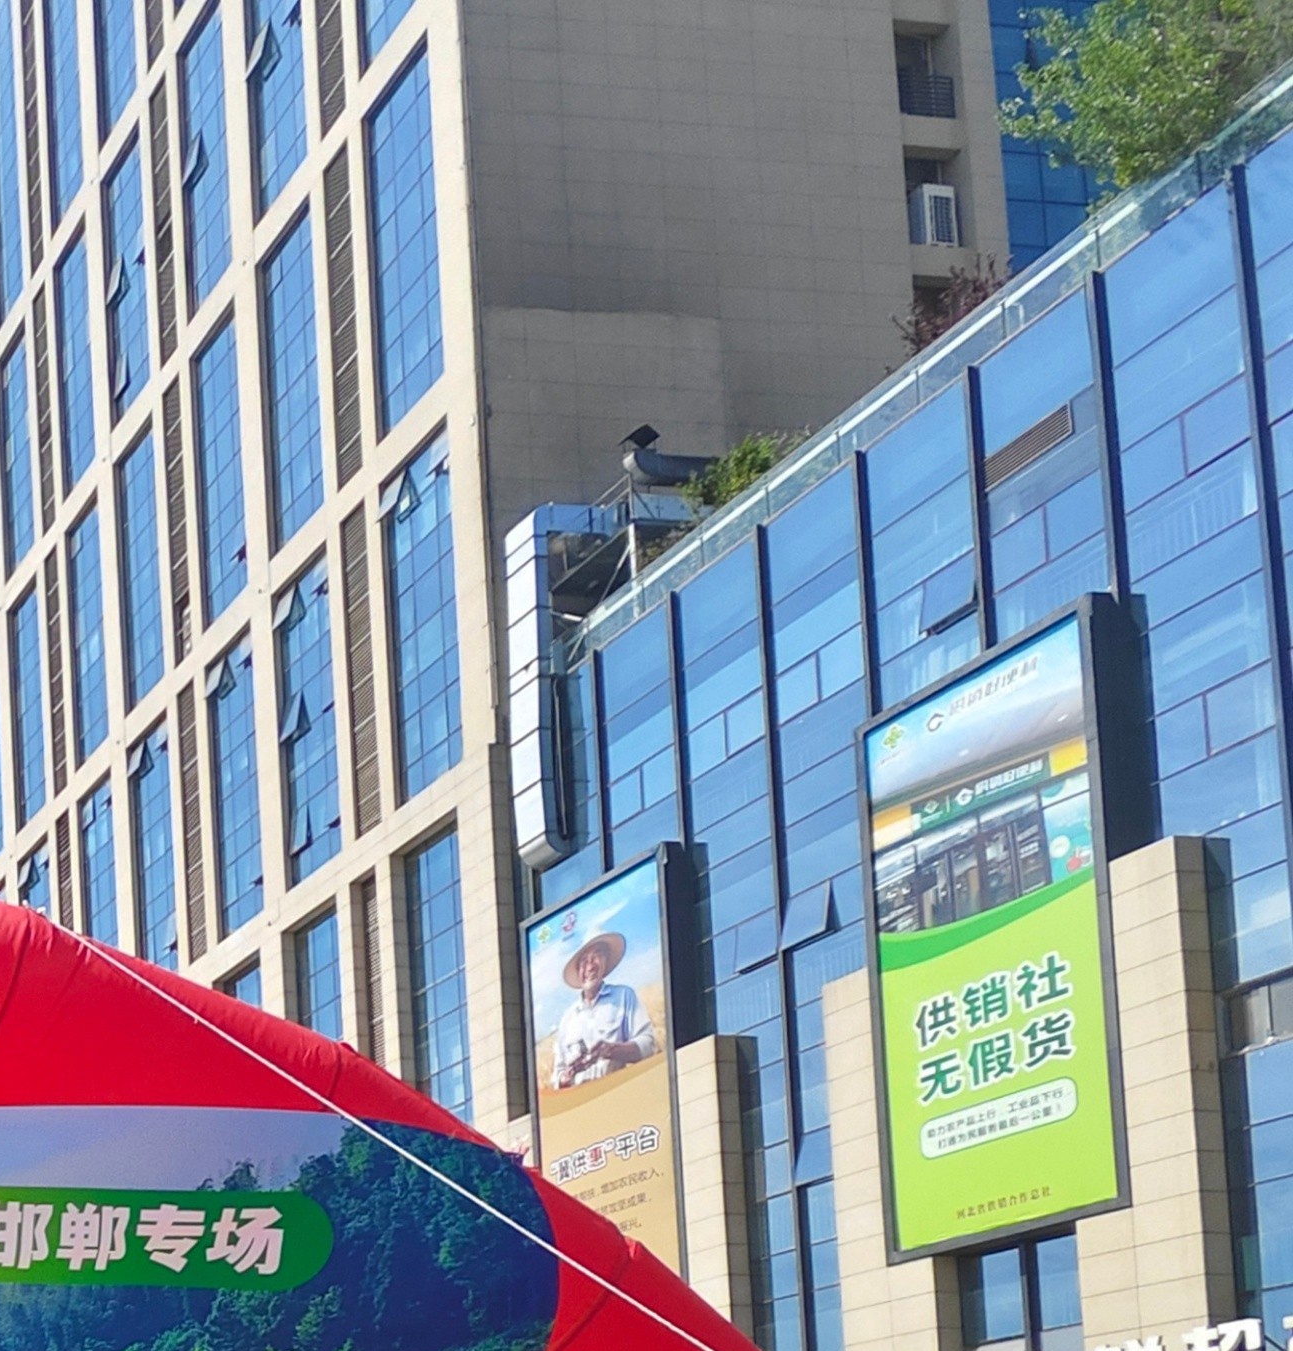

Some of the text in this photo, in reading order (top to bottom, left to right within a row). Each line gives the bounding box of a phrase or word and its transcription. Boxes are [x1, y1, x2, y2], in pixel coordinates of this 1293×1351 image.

[916, 955, 1070, 1047] 供销社
[920, 1013, 1072, 1102] 无假货
